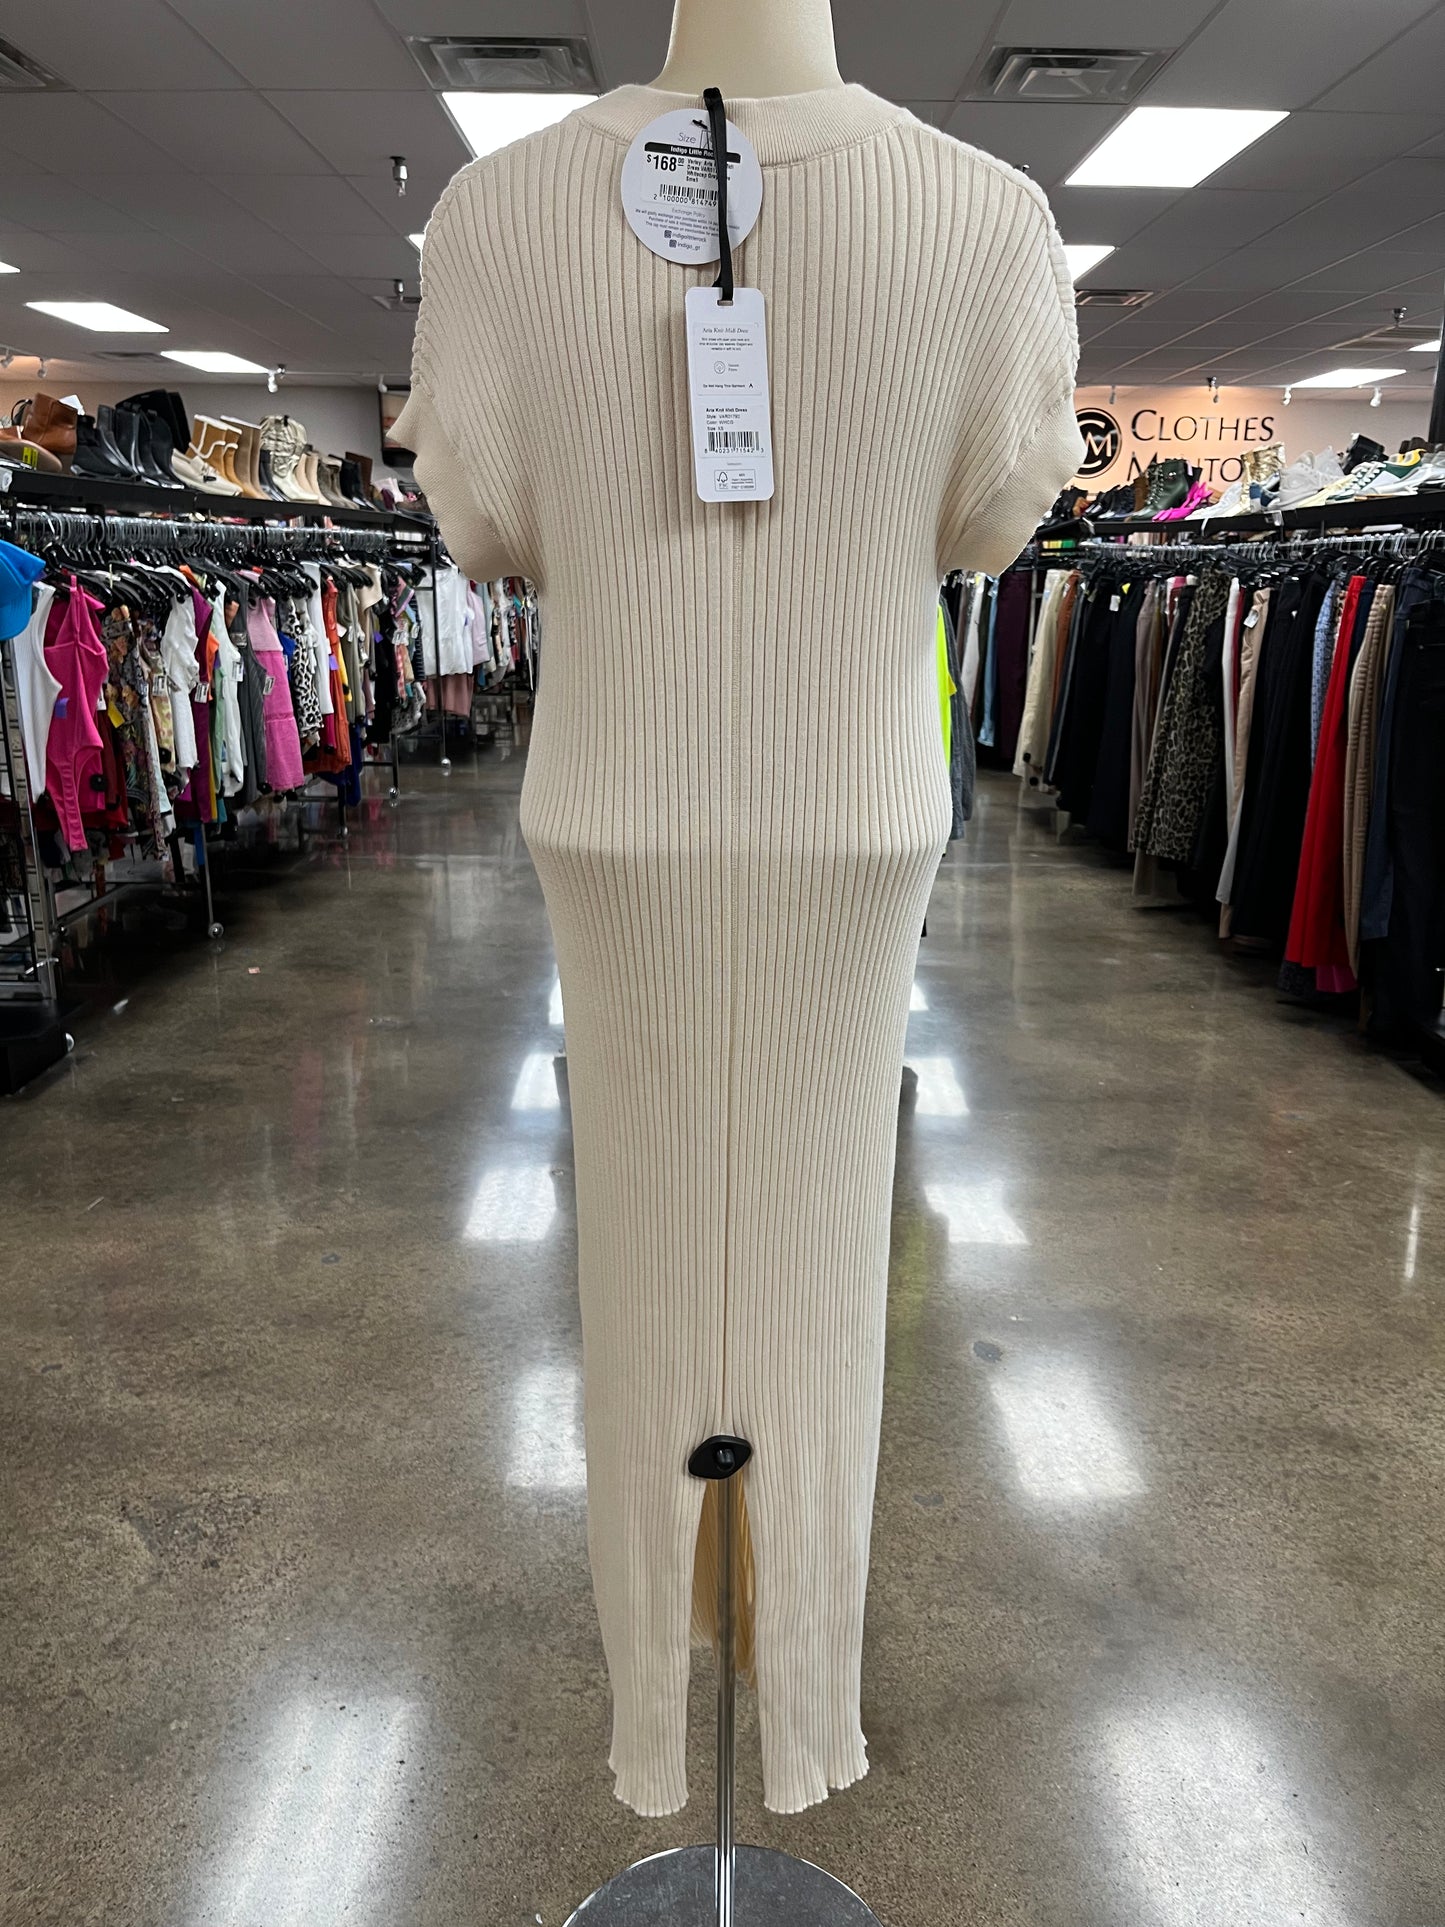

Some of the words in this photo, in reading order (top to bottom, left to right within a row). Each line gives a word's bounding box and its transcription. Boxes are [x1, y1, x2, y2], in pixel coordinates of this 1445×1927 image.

[678, 132, 697, 144] Size
[670, 146, 688, 155] Indigo
[1131, 409, 1274, 442] CLOTHES
